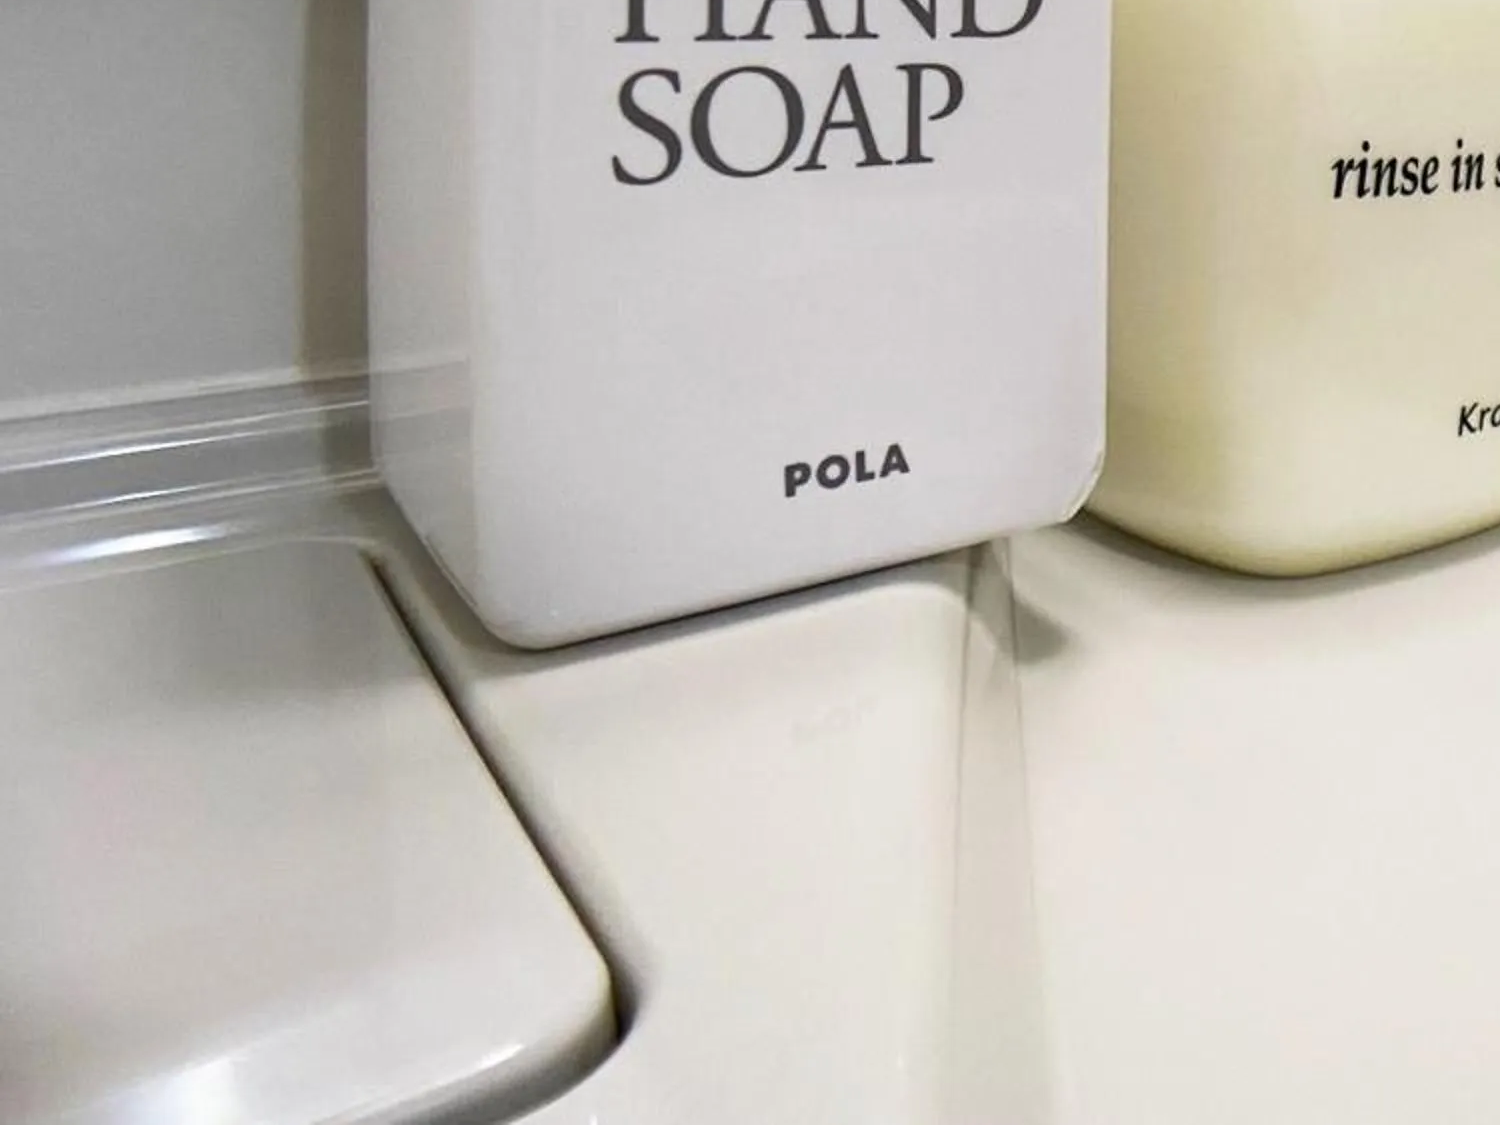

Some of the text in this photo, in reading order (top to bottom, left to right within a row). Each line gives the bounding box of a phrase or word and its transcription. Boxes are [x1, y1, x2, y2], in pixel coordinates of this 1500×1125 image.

[611, 62, 965, 187] SOAP
[1331, 140, 1440, 200] rinse
[1450, 138, 1486, 193] in
[784, 442, 911, 498] POLA
